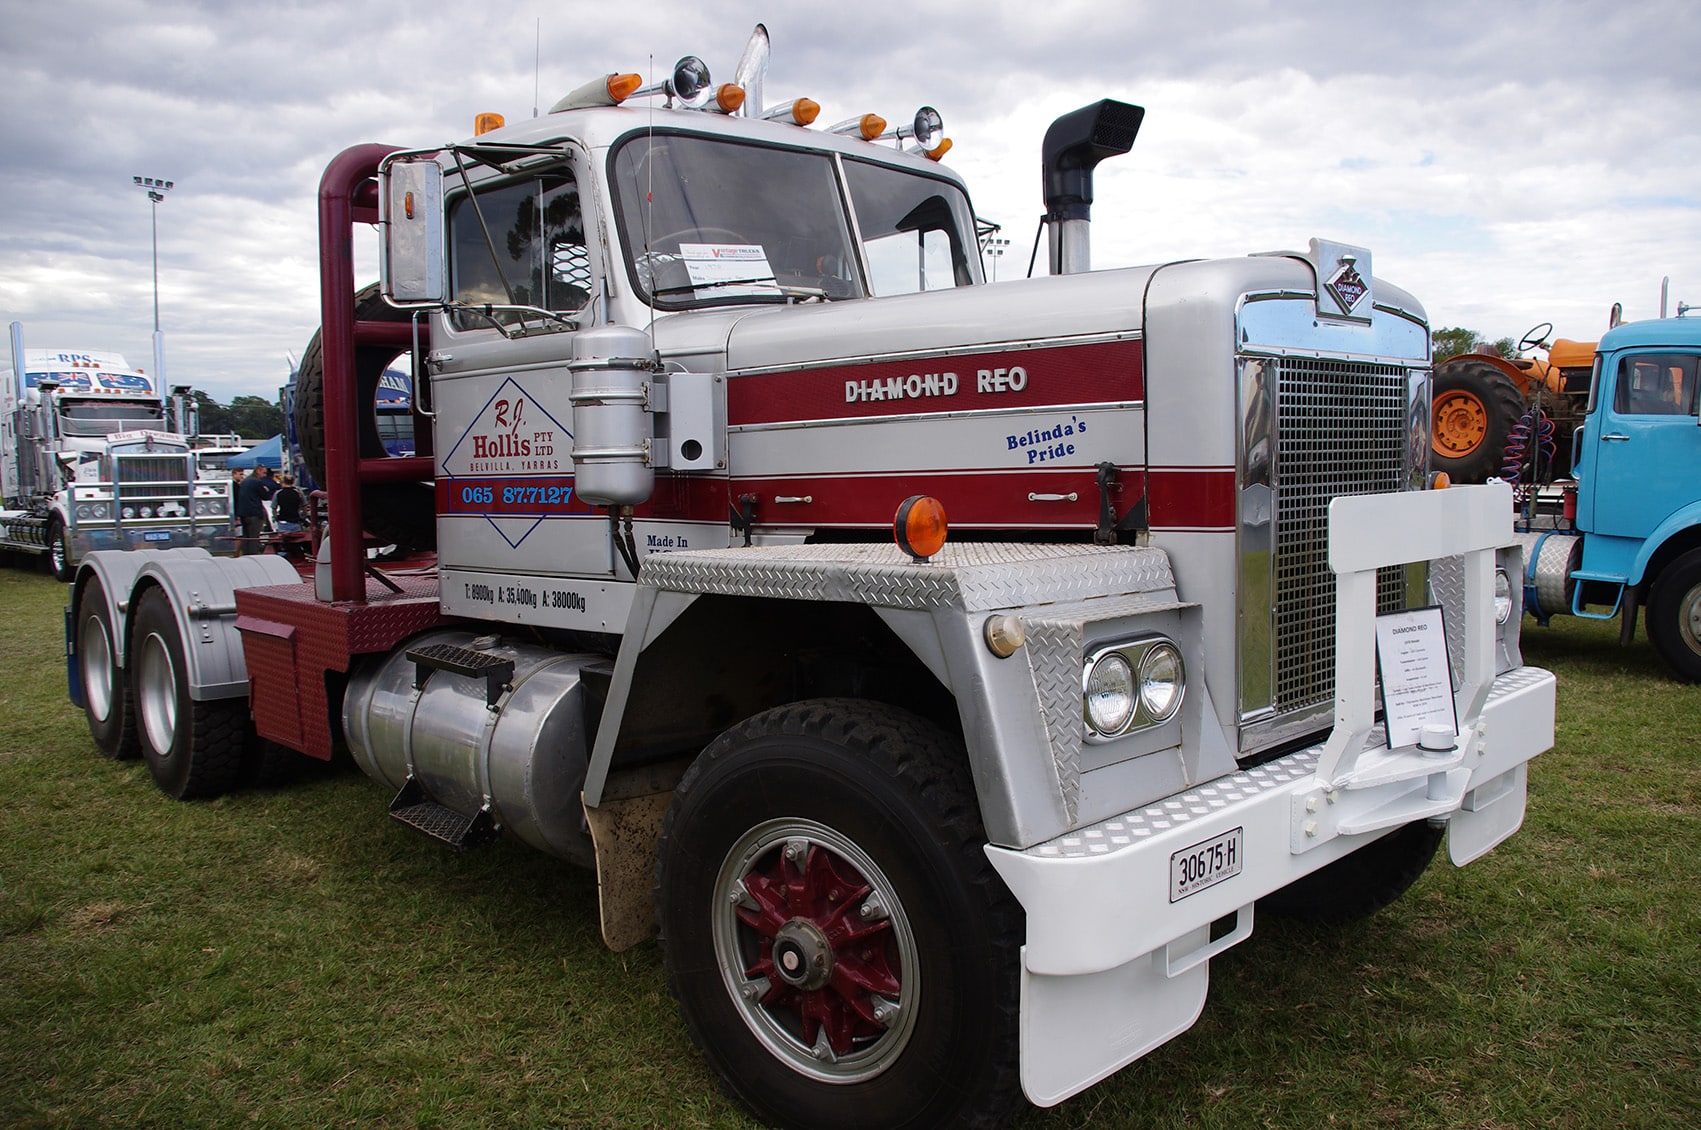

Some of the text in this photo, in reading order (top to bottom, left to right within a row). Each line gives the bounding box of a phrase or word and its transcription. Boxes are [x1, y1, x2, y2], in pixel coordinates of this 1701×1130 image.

[1338, 284, 1362, 294] DIAMOND
[1345, 294, 1355, 303] REO
[58, 353, 92, 363] RPS
[845, 366, 1028, 403] DIAMOND REO
[534, 432, 553, 442] PTY
[1006, 416, 1087, 450] Belinda's
[473, 433, 531, 459] Hollis
[535, 445, 553, 456] LTD
[1027, 443, 1076, 464] Pride
[521, 460, 559, 470] YARRAS
[462, 487, 494, 504] 065
[647, 535, 688, 547] Made In
[498, 586, 504, 603] A:
[542, 590, 549, 607] A:
[552, 590, 586, 613] 38000kg
[1392, 625, 1417, 635] DIAMOND
[1215, 866, 1234, 879] VEHICLE
